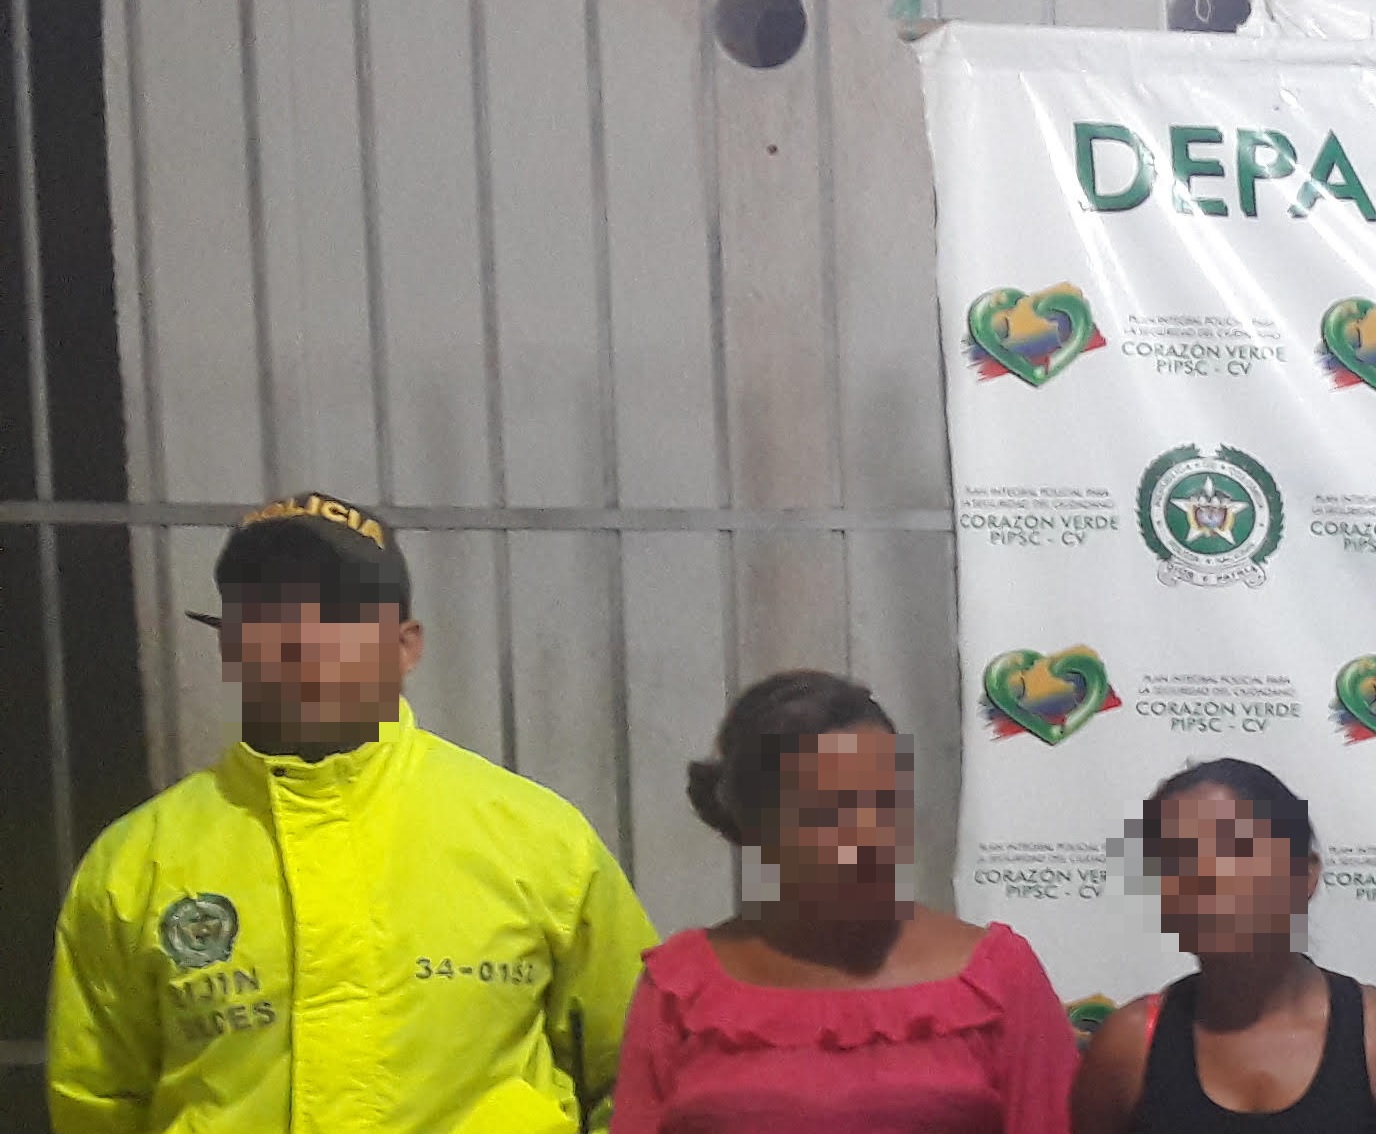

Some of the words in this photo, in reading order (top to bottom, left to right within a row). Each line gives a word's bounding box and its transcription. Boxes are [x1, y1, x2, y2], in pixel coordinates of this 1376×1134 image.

[1225, 345, 1287, 362] VERDE
[1157, 360, 1207, 376] PIPSC
[1227, 360, 1251, 375] CV
[1061, 515, 1118, 530] VERDE
[1062, 531, 1085, 545] CV
[1241, 702, 1301, 718] VERDE
[1242, 718, 1267, 732] CV
[1078, 869, 1106, 883] VER
[1079, 885, 1103, 899] CV
